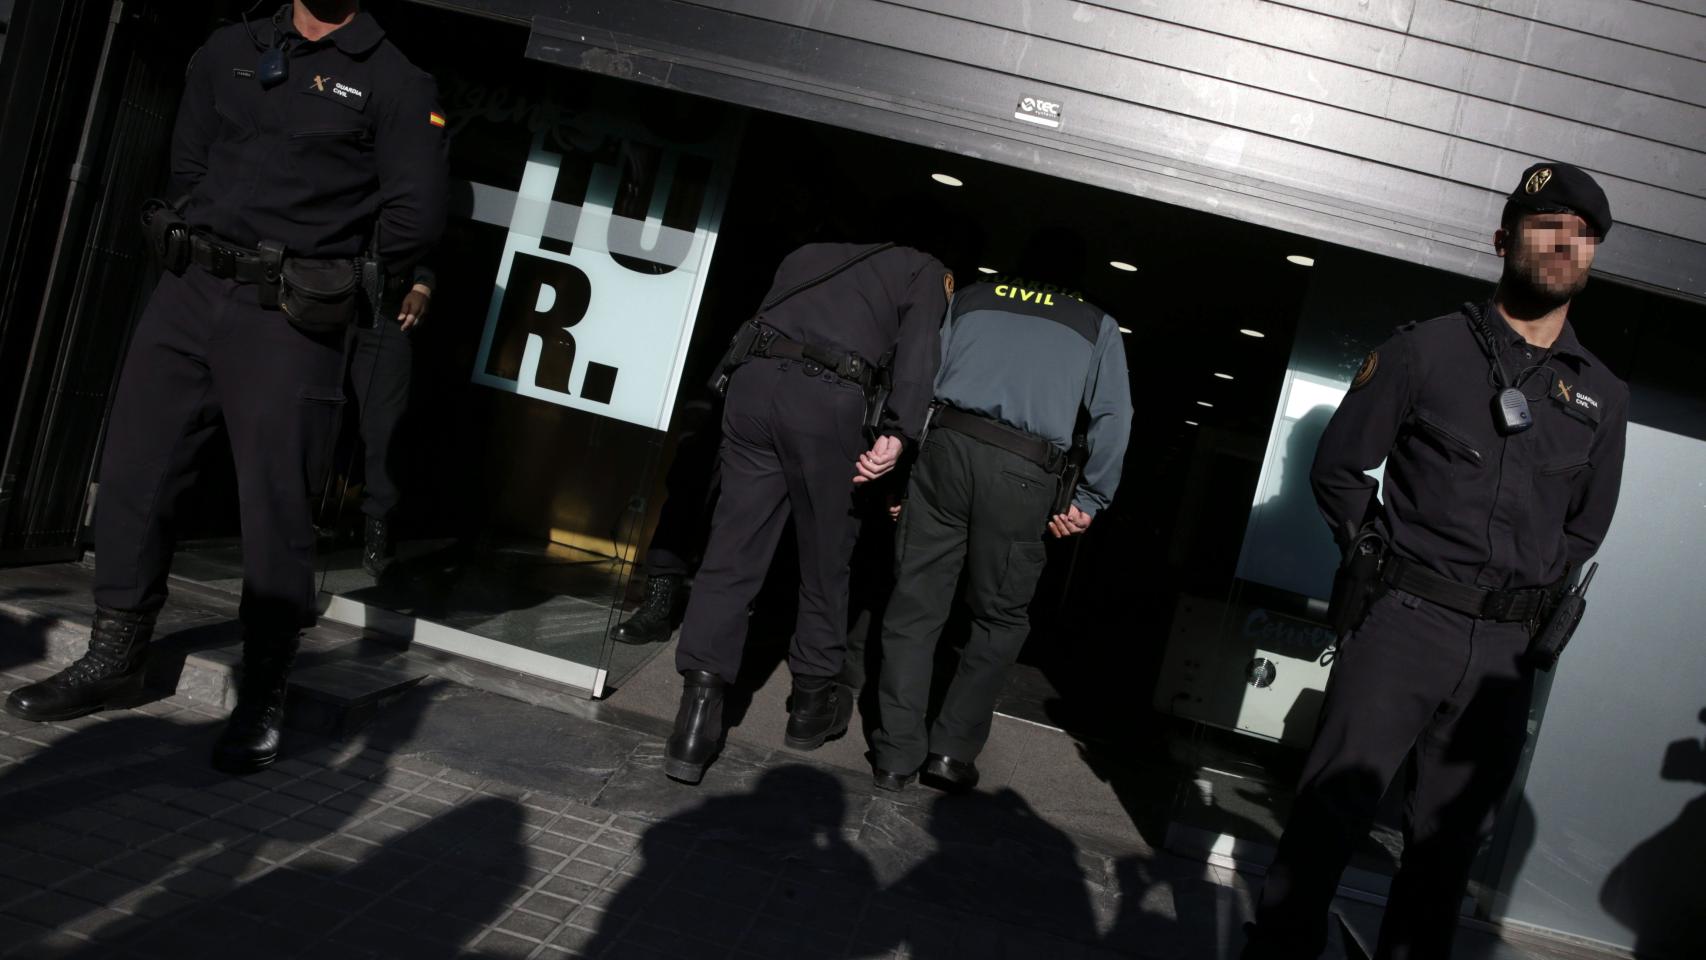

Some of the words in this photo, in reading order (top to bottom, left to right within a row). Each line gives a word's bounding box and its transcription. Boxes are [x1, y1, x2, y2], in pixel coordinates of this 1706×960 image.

[332, 87, 348, 98] CIVIL
[335, 82, 362, 97] GUARDIA
[1036, 99, 1060, 115] tec
[994, 284, 1054, 306] CIVIL
[484, 251, 618, 404] R.
[1575, 392, 1598, 408] GUARDIA
[1575, 399, 1589, 409] CIVIL
